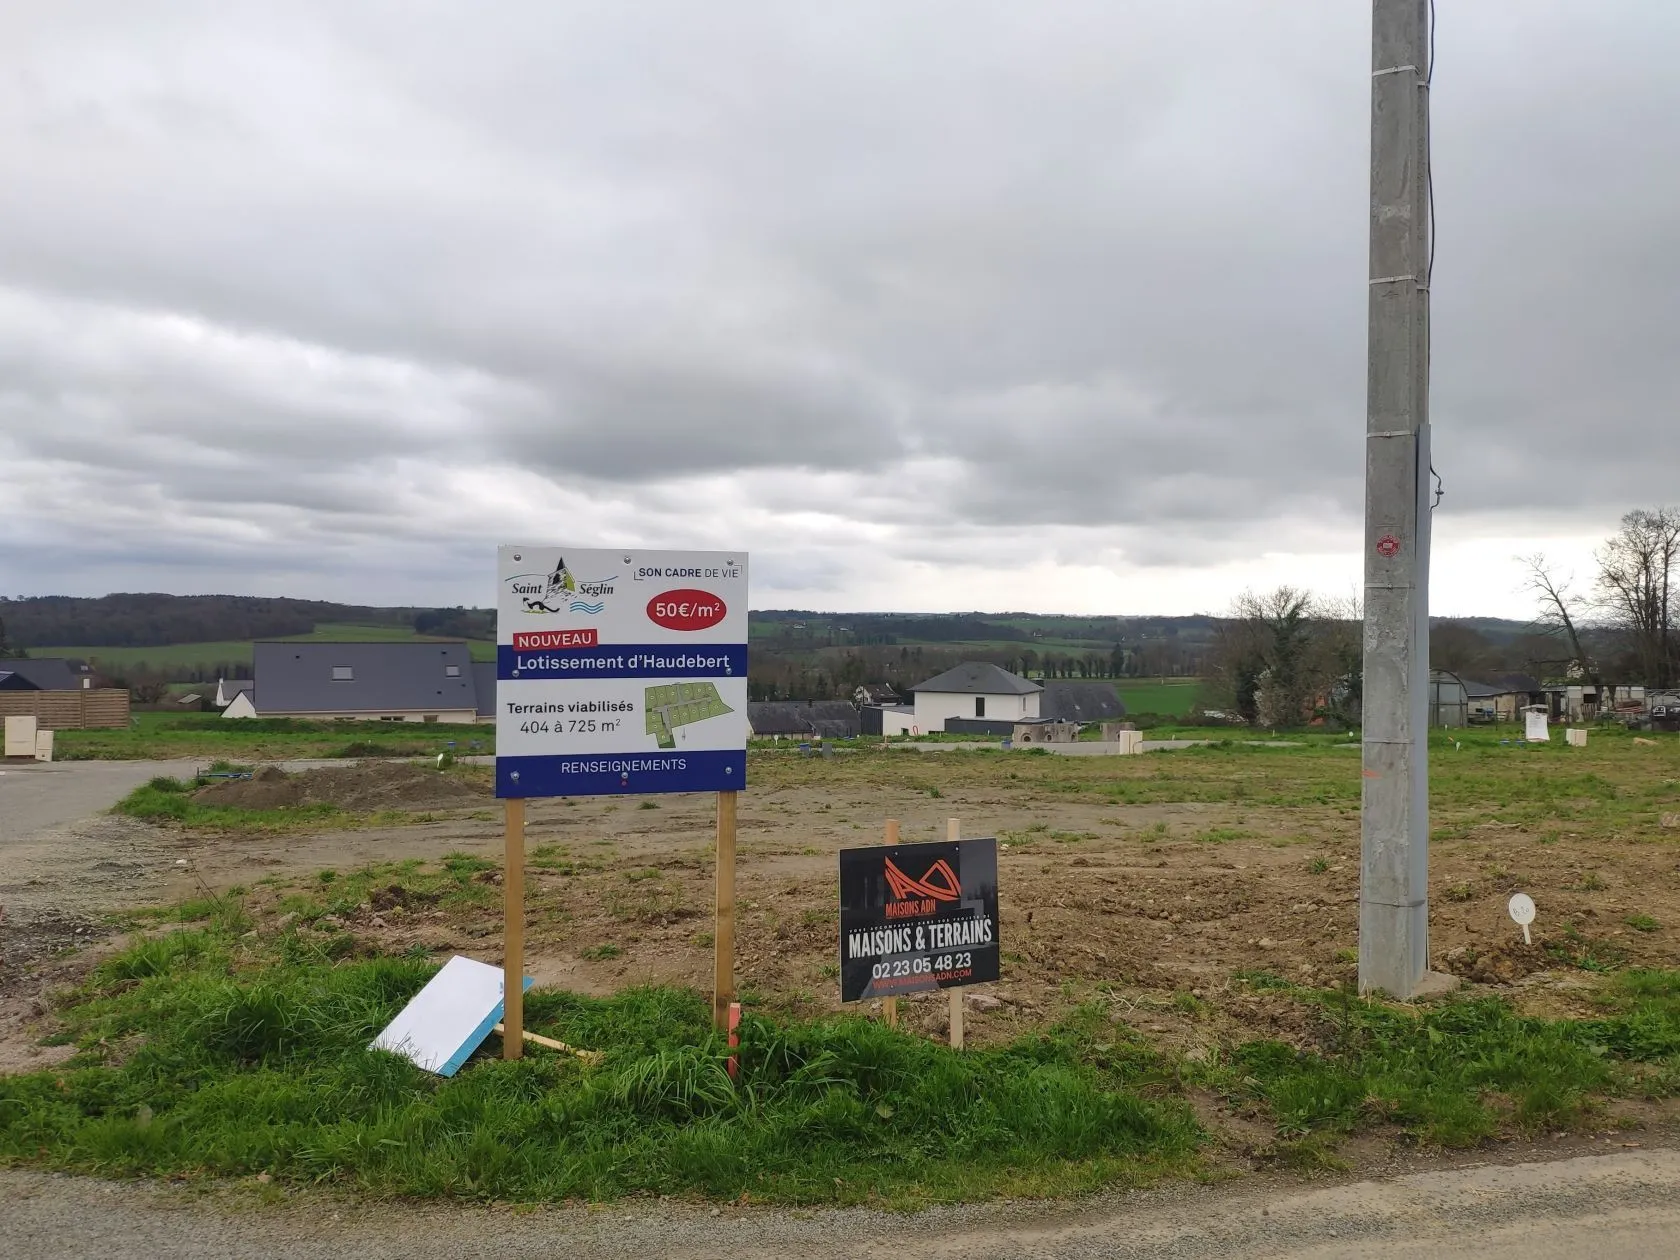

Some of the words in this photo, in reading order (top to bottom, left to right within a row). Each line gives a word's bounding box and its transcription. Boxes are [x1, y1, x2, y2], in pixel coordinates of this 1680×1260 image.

[639, 568, 662, 578] SON
[665, 568, 702, 578] CADRE
[704, 569, 719, 578] DE
[721, 569, 738, 578] VIE
[512, 582, 542, 594] Saint
[579, 582, 614, 597] Séglin
[518, 632, 592, 648] NOUVEAU
[518, 655, 624, 670] Lotissement
[628, 654, 730, 668] d'Haudebert
[507, 702, 564, 714] Terrains
[568, 701, 634, 713] viabilisés
[520, 720, 550, 734] 404
[554, 720, 563, 733] à
[568, 720, 596, 733] 725
[561, 758, 687, 774] RENSEIGNEMENTS
[886, 900, 920, 917] MAISONS
[920, 898, 936, 913] ADN
[848, 927, 912, 958] MAISONS
[915, 926, 926, 950] &
[928, 918, 992, 948] TERRAINS
[872, 962, 890, 979] 02
[893, 960, 910, 976] 23
[913, 957, 932, 974] 05
[934, 954, 952, 972] 48
[955, 952, 972, 969] 23
